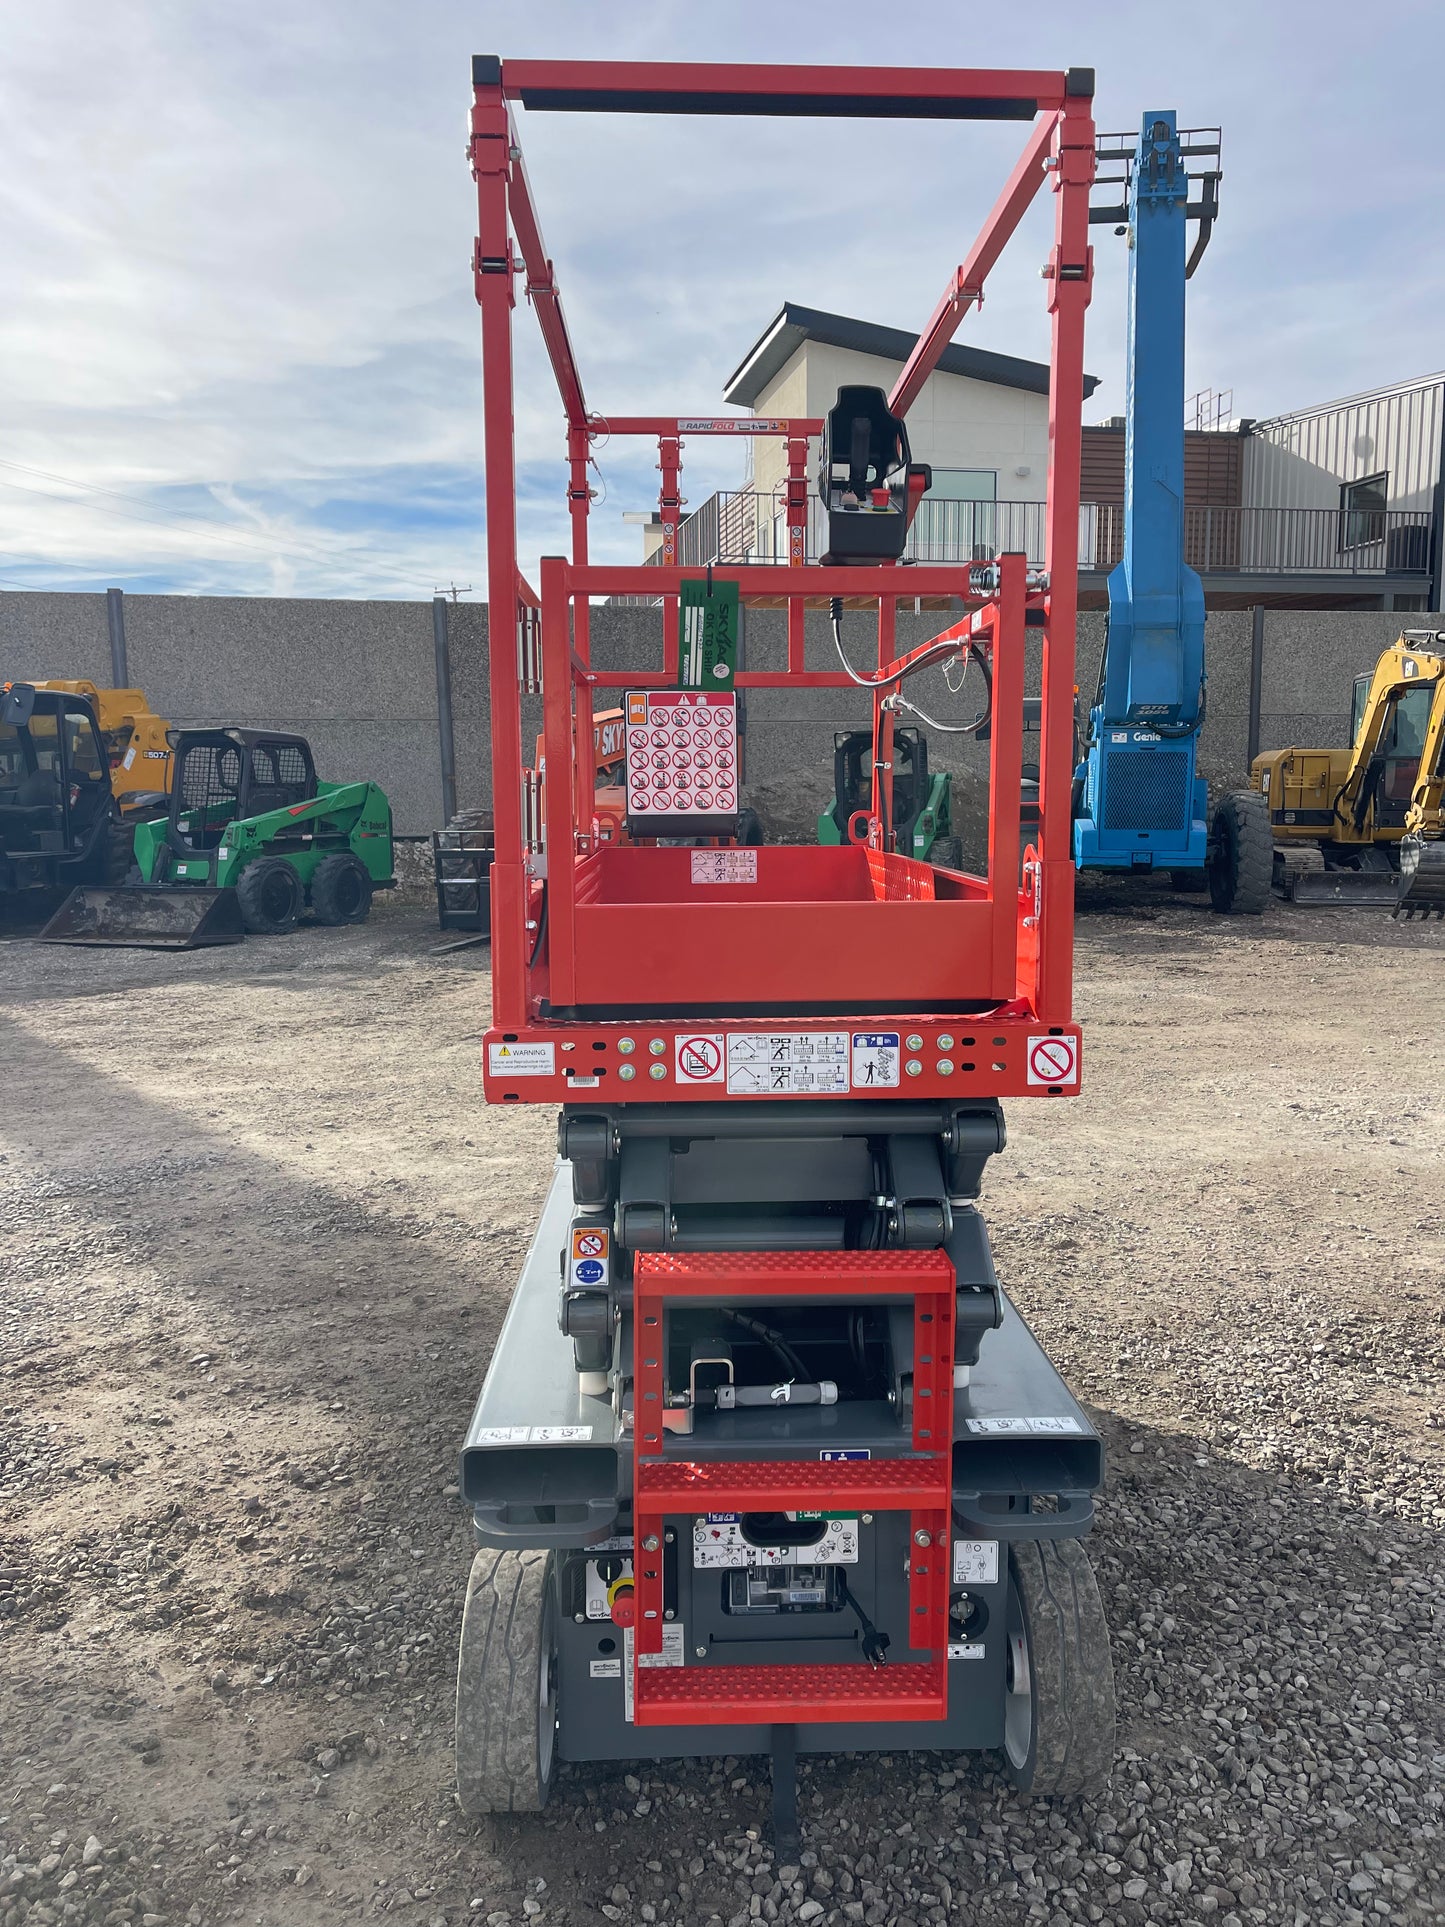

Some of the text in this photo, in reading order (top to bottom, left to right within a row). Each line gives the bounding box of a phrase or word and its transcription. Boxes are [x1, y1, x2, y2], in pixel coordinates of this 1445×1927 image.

[704, 613, 715, 674] OK TO SHIP
[715, 603, 733, 675] SKYJAC
[1133, 732, 1162, 742] Genie
